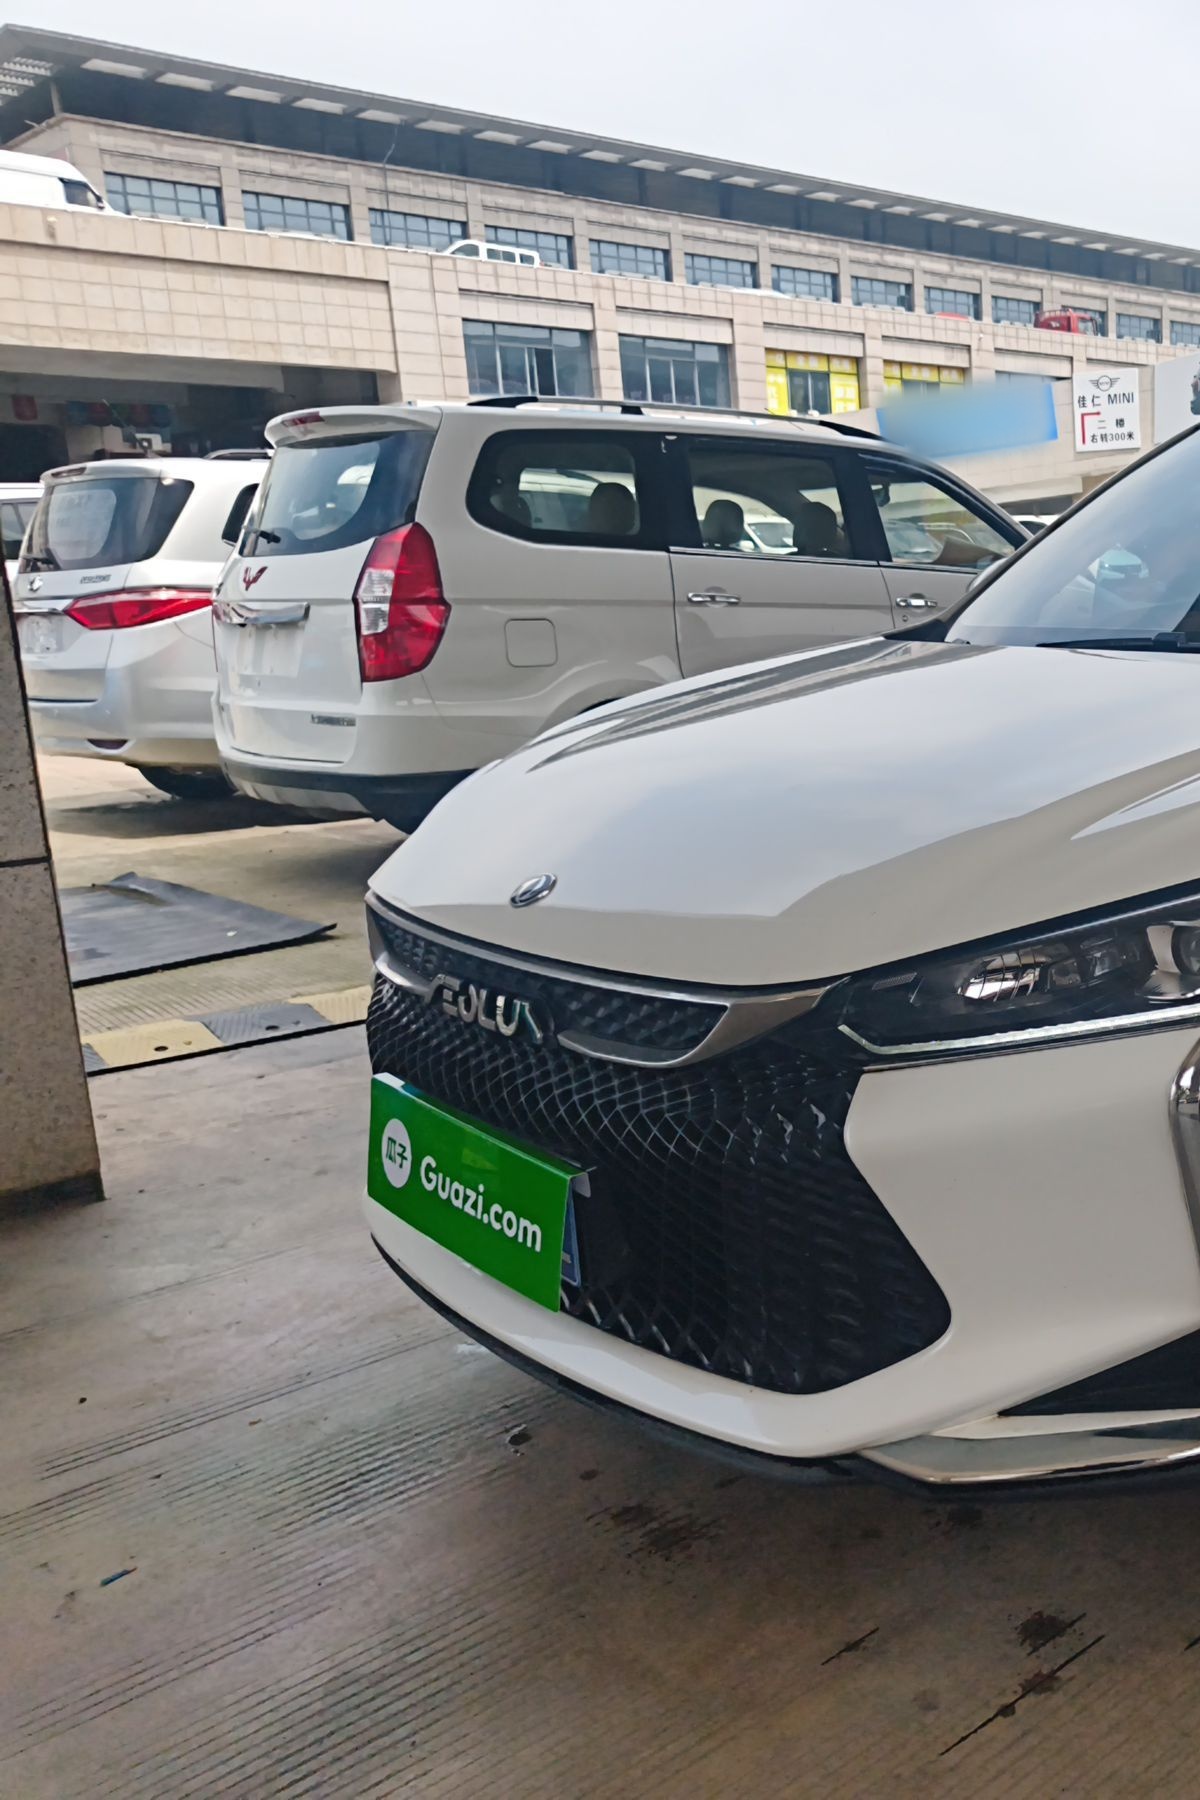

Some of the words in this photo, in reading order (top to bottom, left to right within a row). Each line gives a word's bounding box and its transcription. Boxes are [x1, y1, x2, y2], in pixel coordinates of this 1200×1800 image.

[1107, 392, 1134, 405] MINI
[1091, 431, 1135, 443] 右转300米
[385, 1136, 408, 1169] 瓜子
[420, 1154, 542, 1253] Guazi.com
